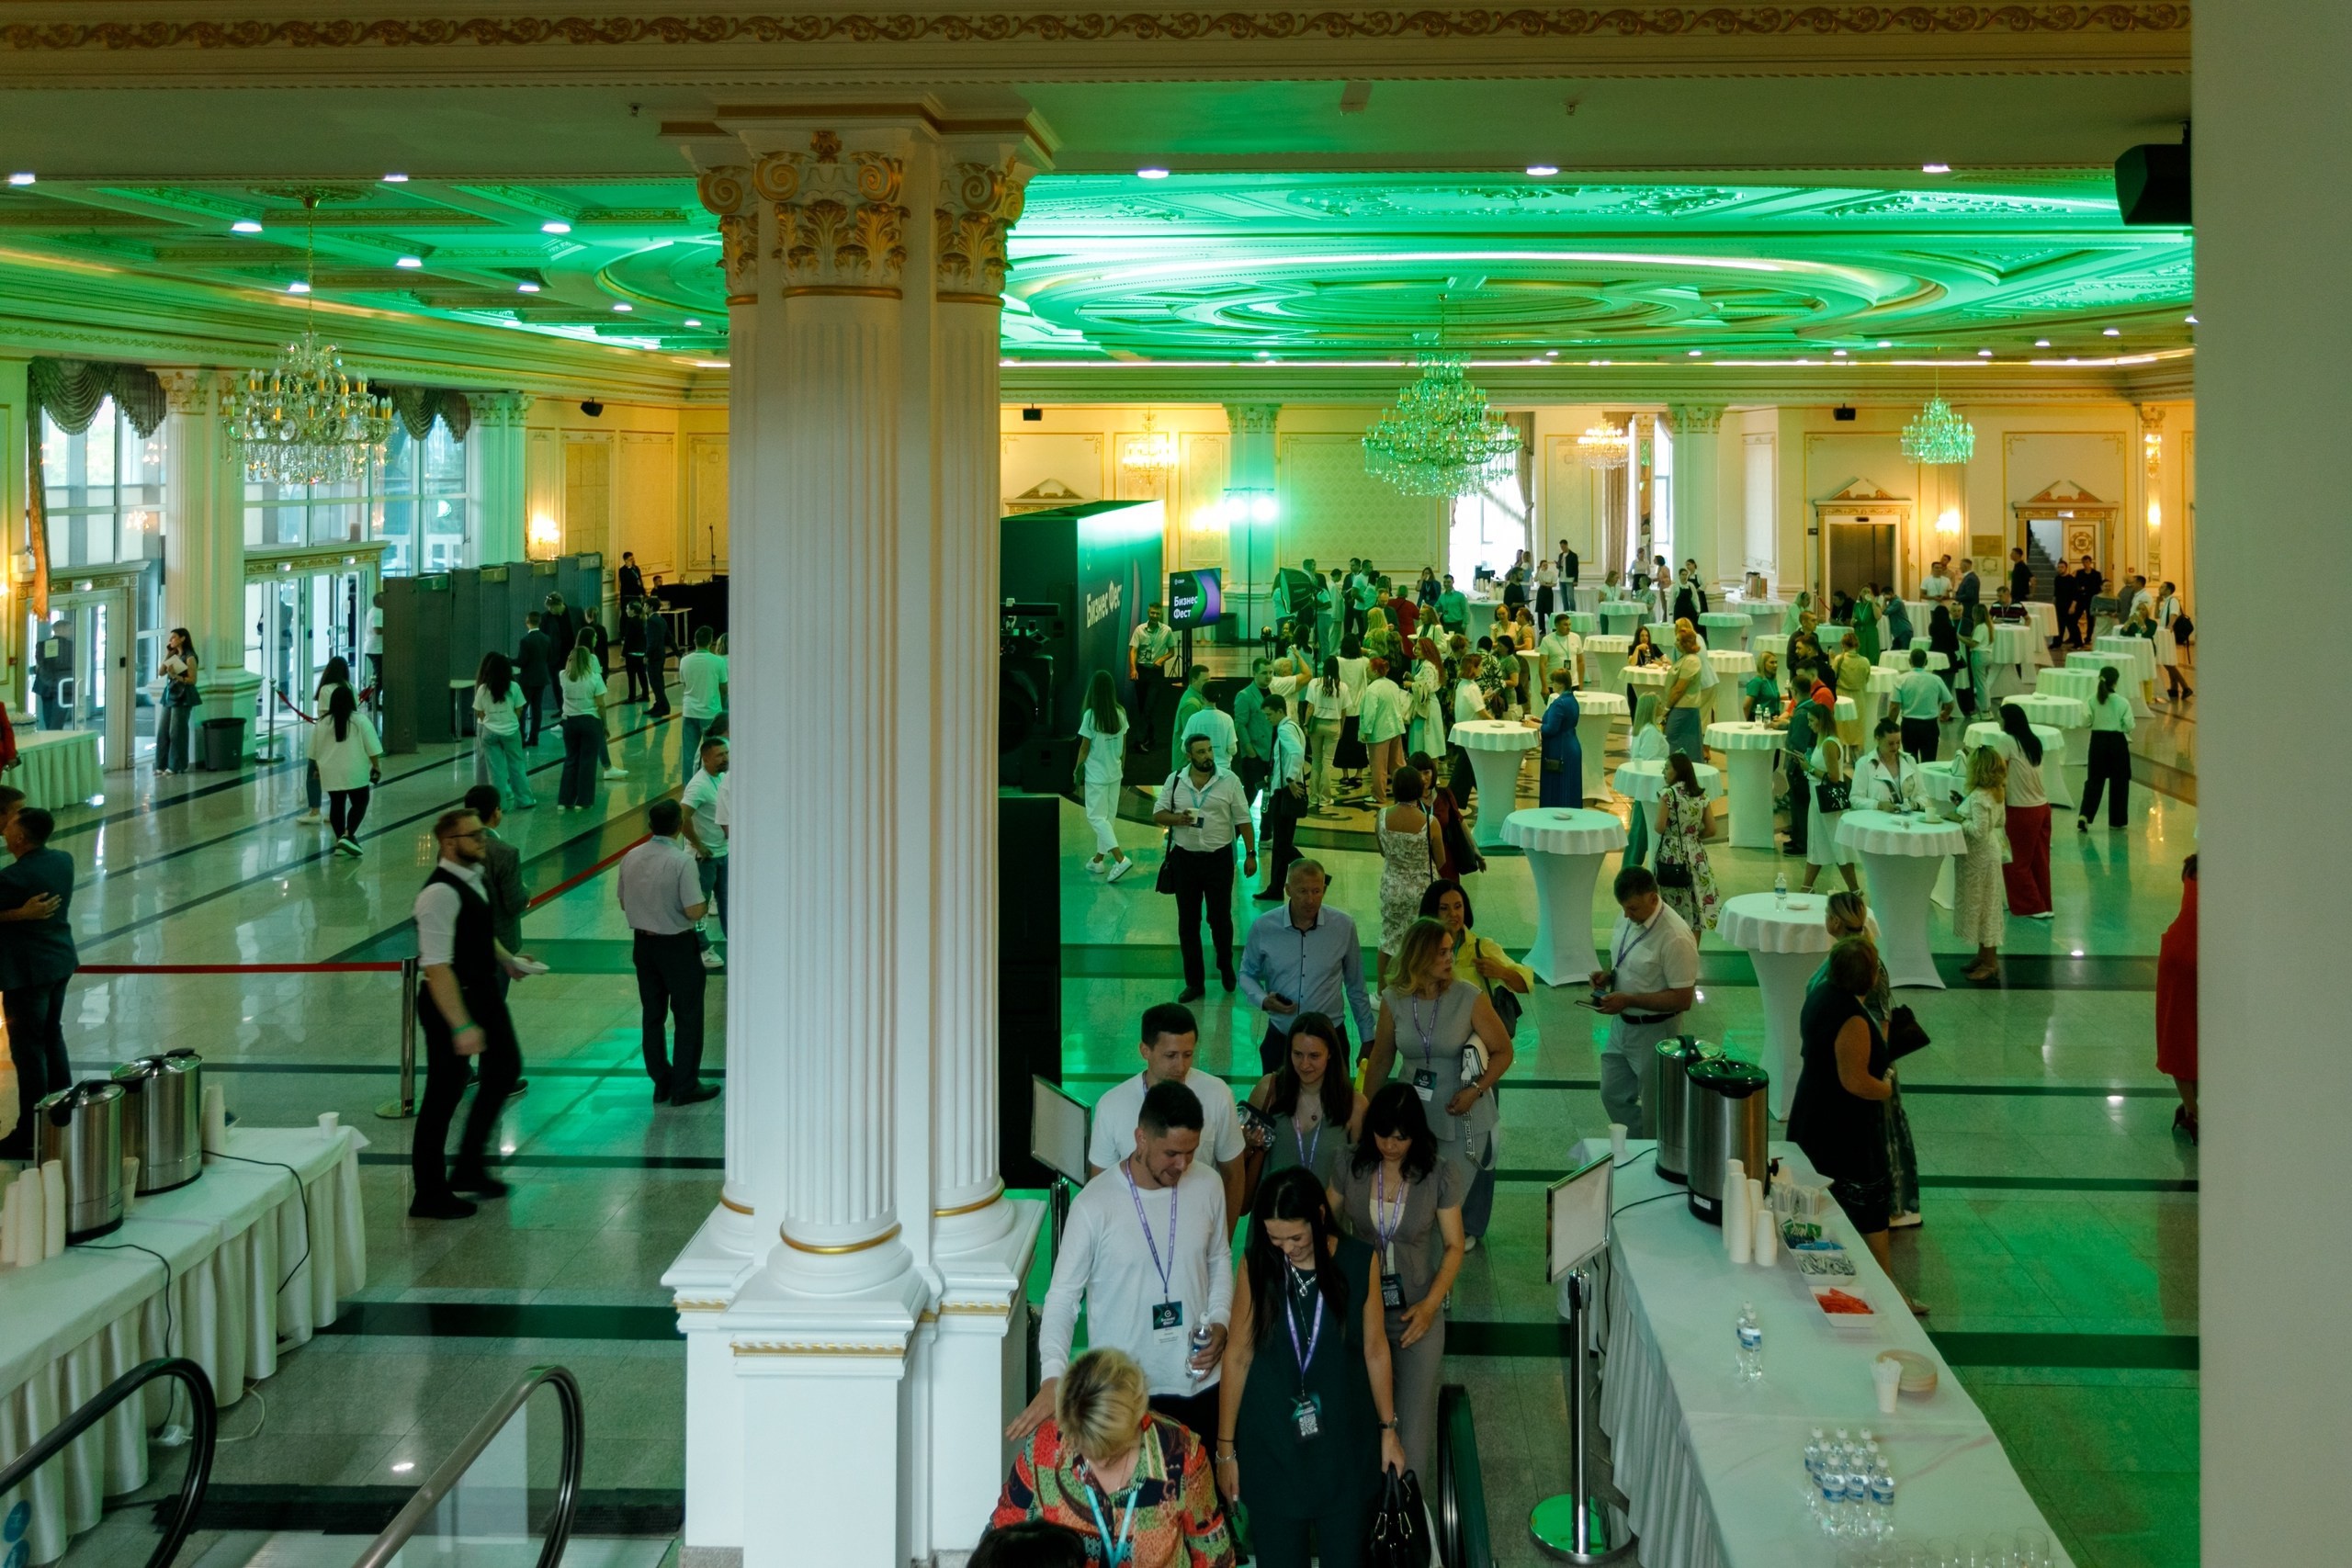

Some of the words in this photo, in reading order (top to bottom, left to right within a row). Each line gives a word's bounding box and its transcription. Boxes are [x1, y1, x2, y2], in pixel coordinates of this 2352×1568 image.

[1174, 596, 1198, 606] Бизнес
[1087, 592, 1108, 628] Бизнес
[1173, 608, 1191, 619] Фест
